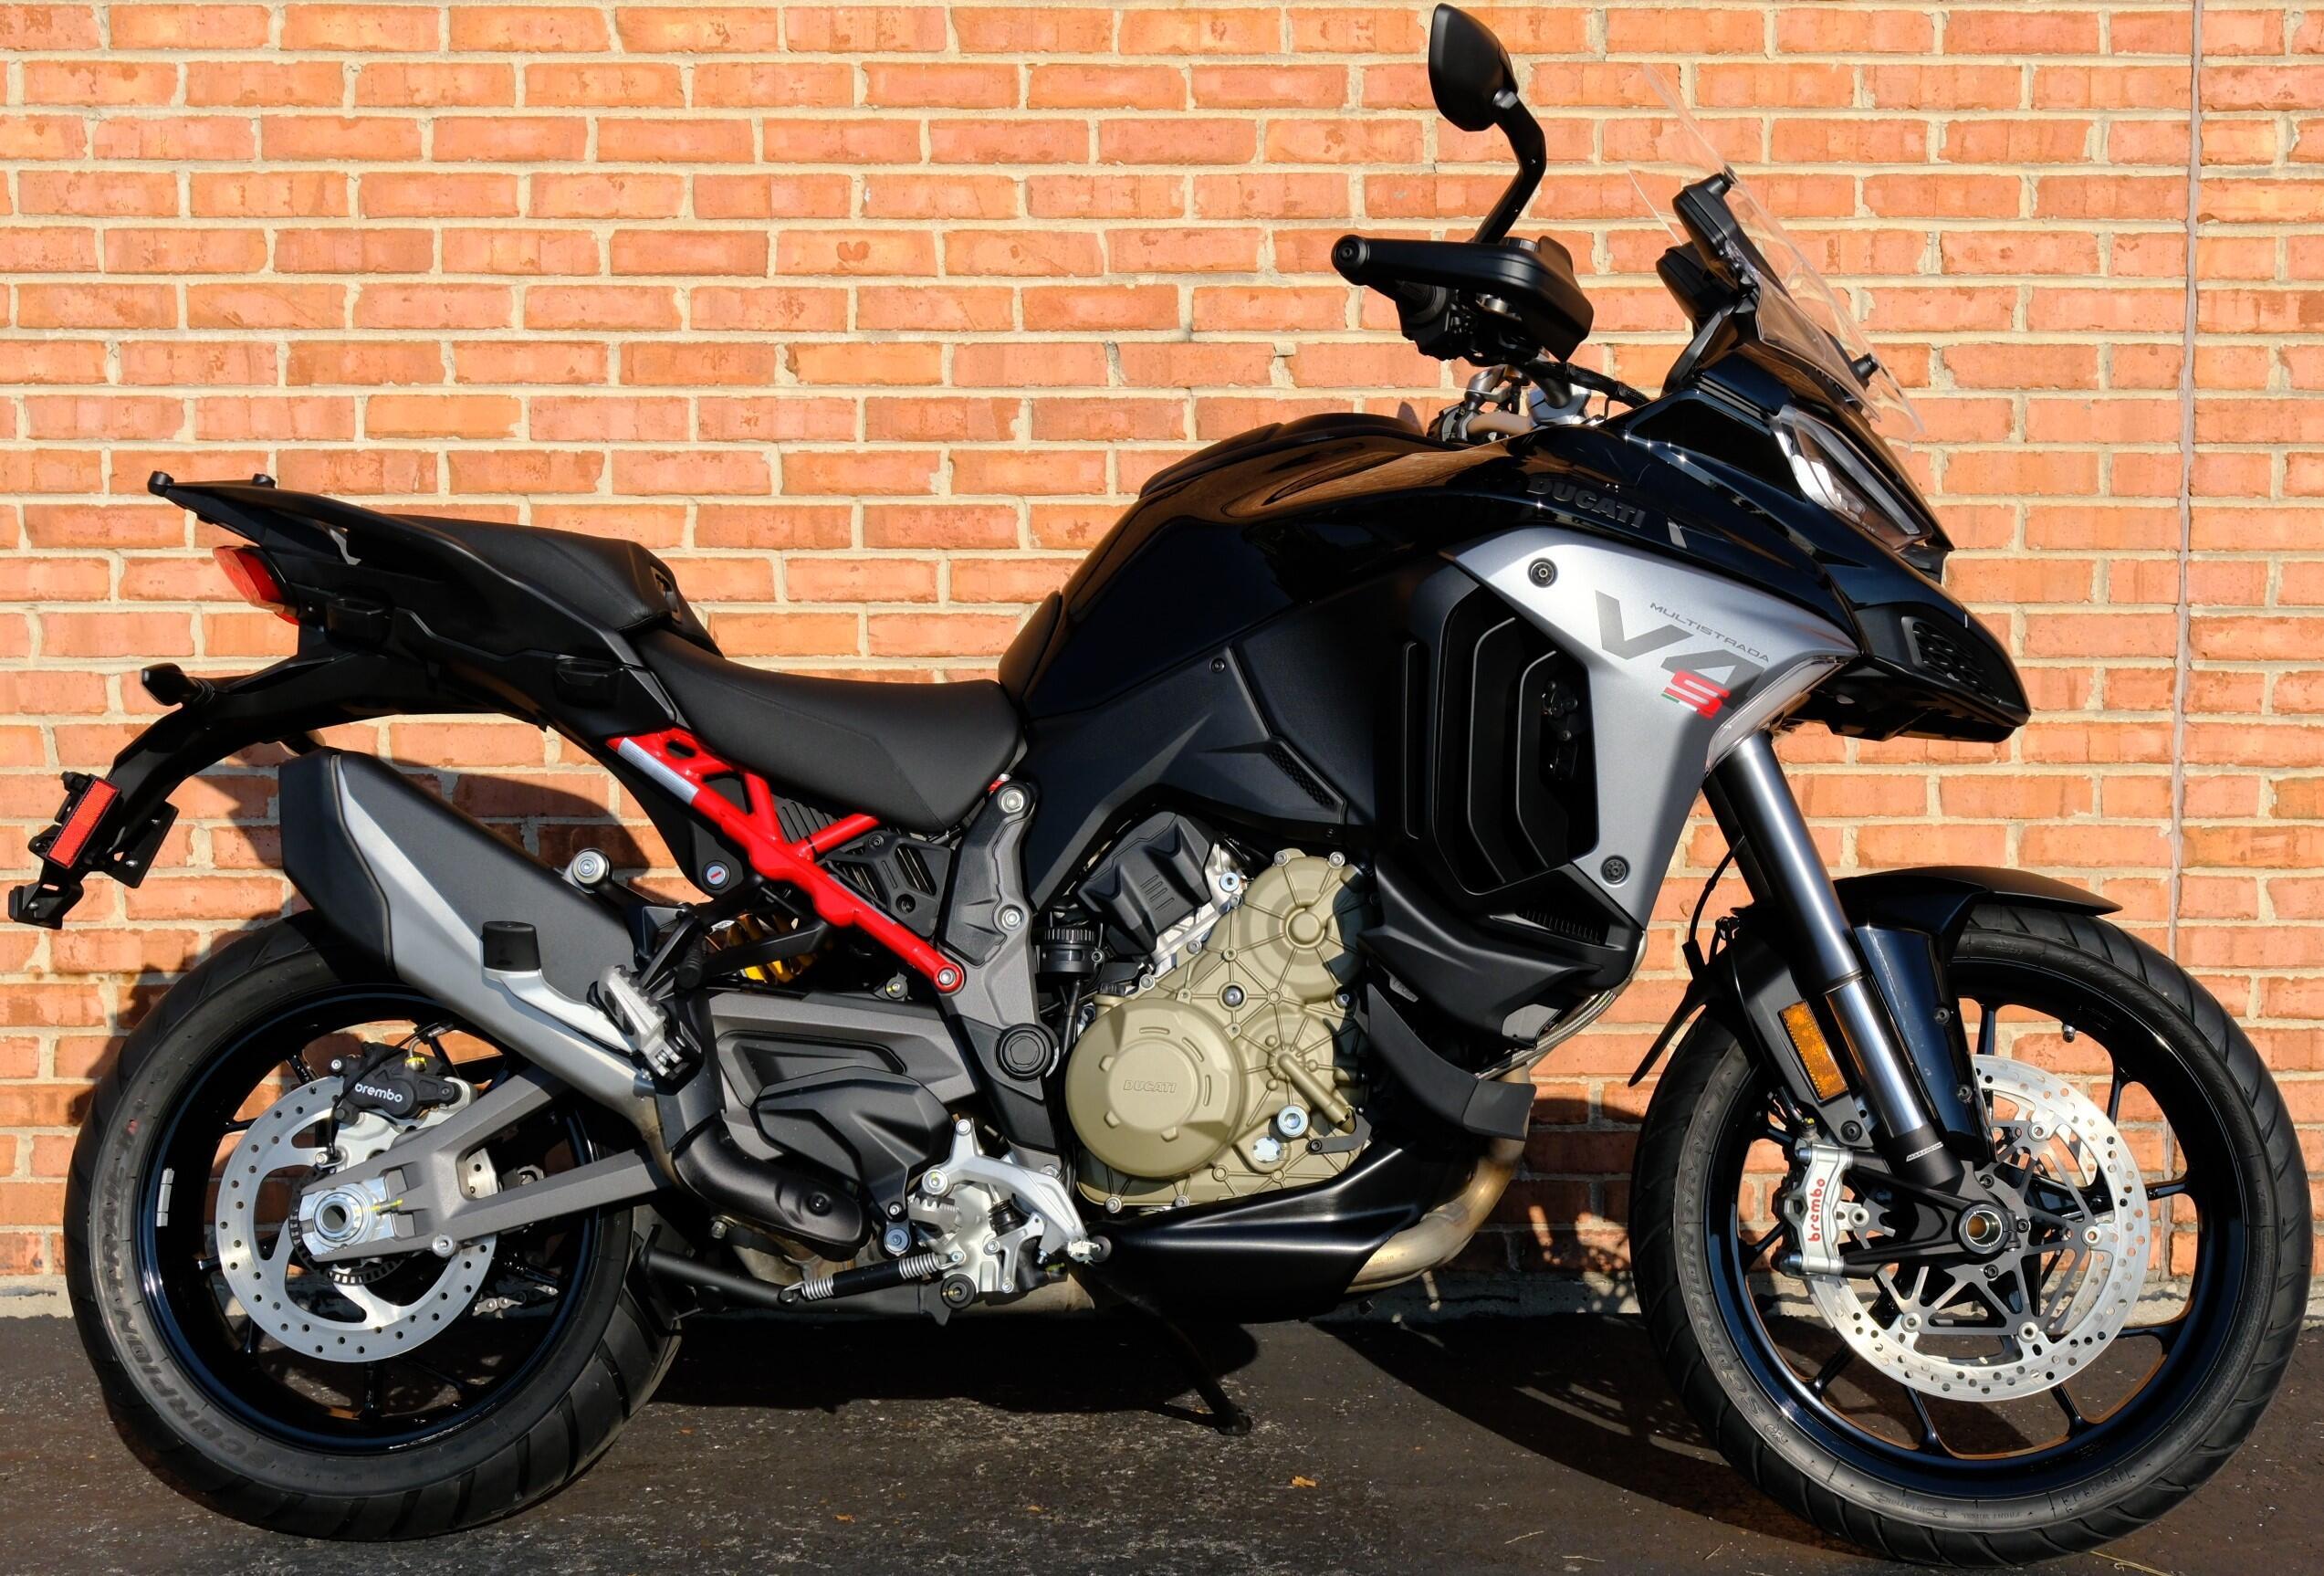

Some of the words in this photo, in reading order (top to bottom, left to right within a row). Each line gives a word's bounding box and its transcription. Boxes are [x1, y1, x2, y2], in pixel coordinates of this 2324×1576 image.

[1526, 477, 1646, 529] DUCATI
[1649, 602, 1770, 663] MULTISTRADA
[354, 1081, 403, 1103] brembo
[1123, 1079, 1177, 1093] DUCATI
[1807, 1178, 1827, 1243] brembo
